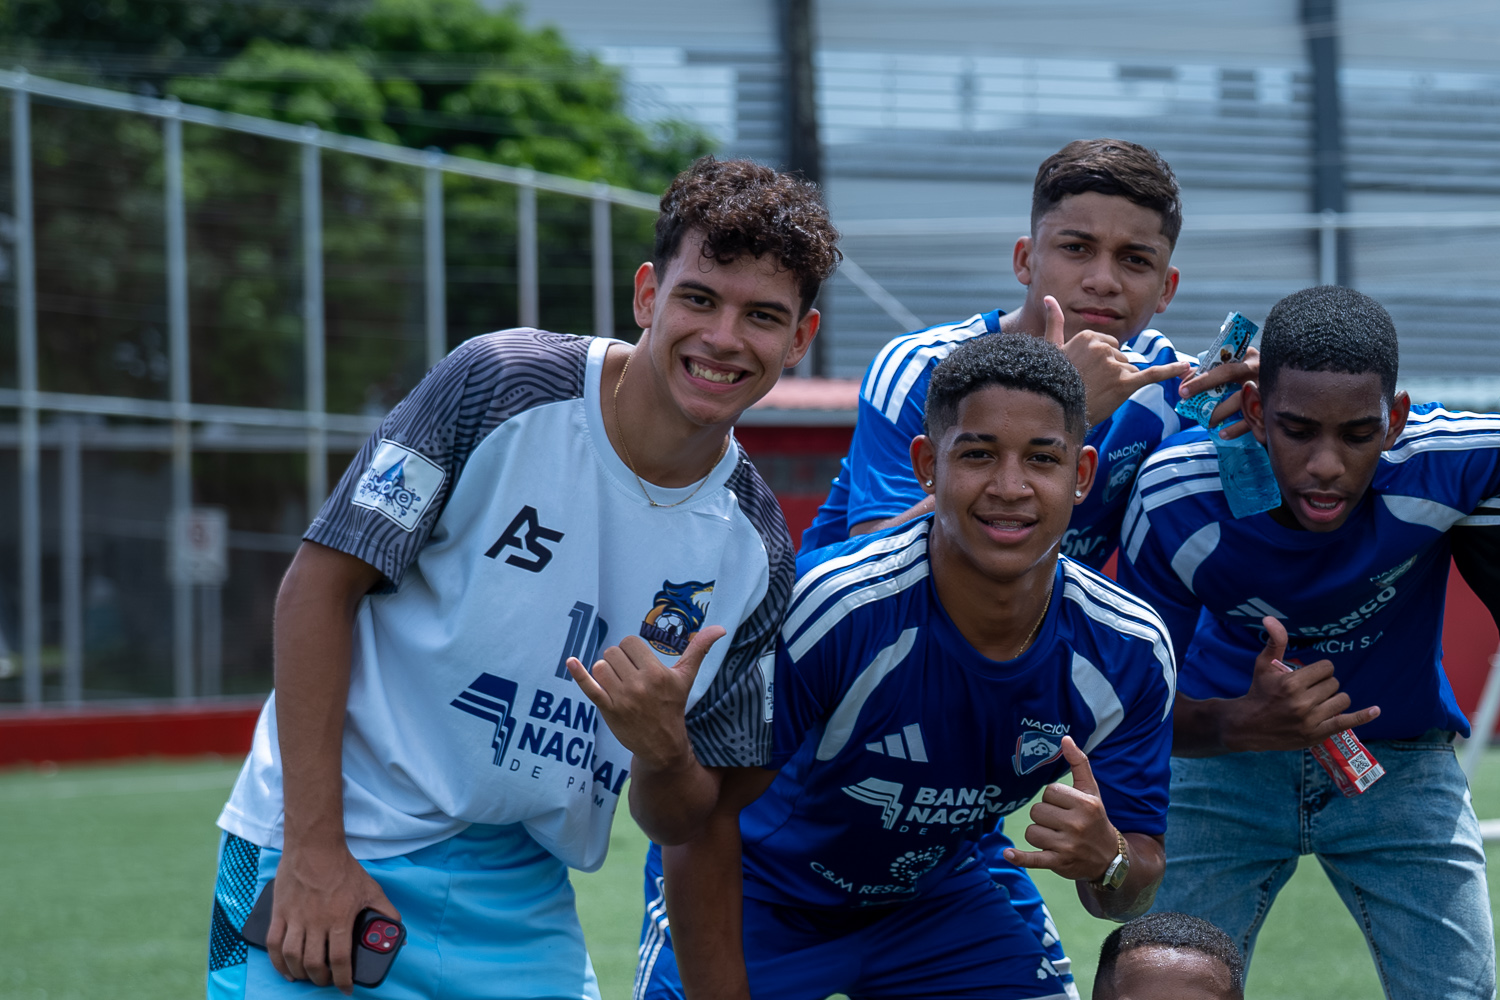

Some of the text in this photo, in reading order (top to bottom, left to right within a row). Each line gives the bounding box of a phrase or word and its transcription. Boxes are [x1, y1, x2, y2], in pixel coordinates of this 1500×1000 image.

[641, 621, 690, 651] WOLVE
[509, 758, 543, 780] DE
[899, 825, 928, 836] DE
[810, 861, 853, 893] C&M
